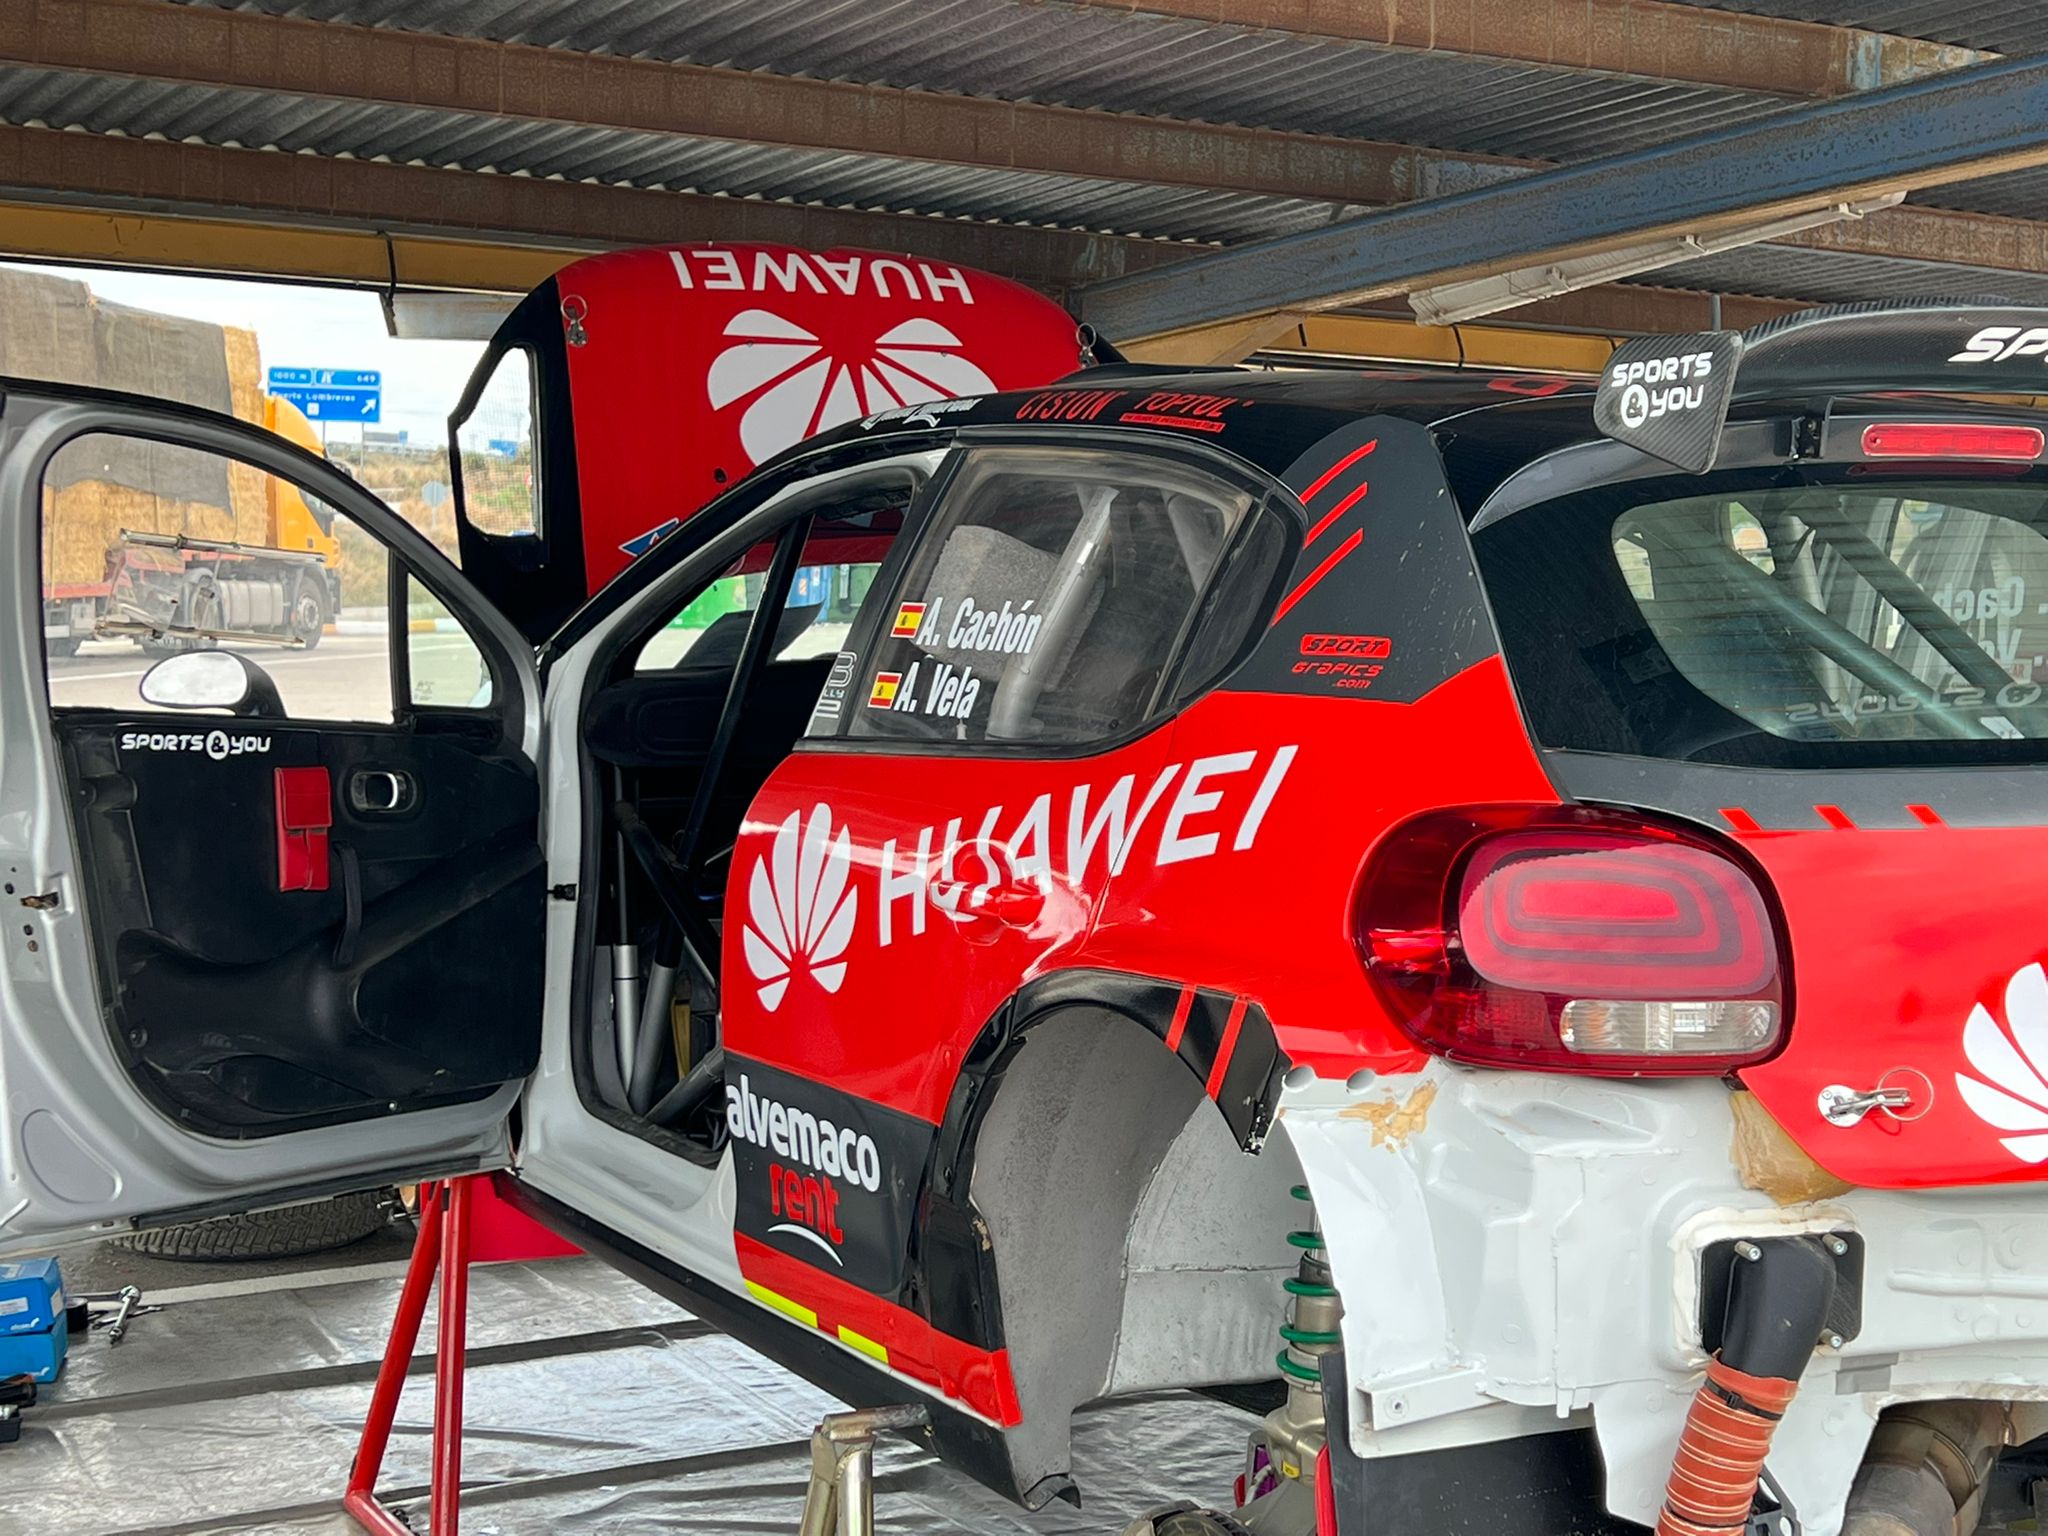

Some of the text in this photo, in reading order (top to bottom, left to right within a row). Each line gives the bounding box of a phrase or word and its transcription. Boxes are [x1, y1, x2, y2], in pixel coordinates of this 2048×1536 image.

[669, 251, 975, 304] HUAWEI
[1611, 352, 1713, 387] SPORTS
[1947, 327, 2048, 362] SP
[357, 375, 376, 384] 649
[916, 597, 1042, 654] A. Cachón
[1306, 639, 1384, 653] SPORT
[894, 661, 920, 713] A.
[925, 663, 981, 719] Vela
[879, 744, 1299, 948] HUAWEI
[726, 1074, 881, 1192] alvemaco
[769, 1162, 843, 1245] rent
